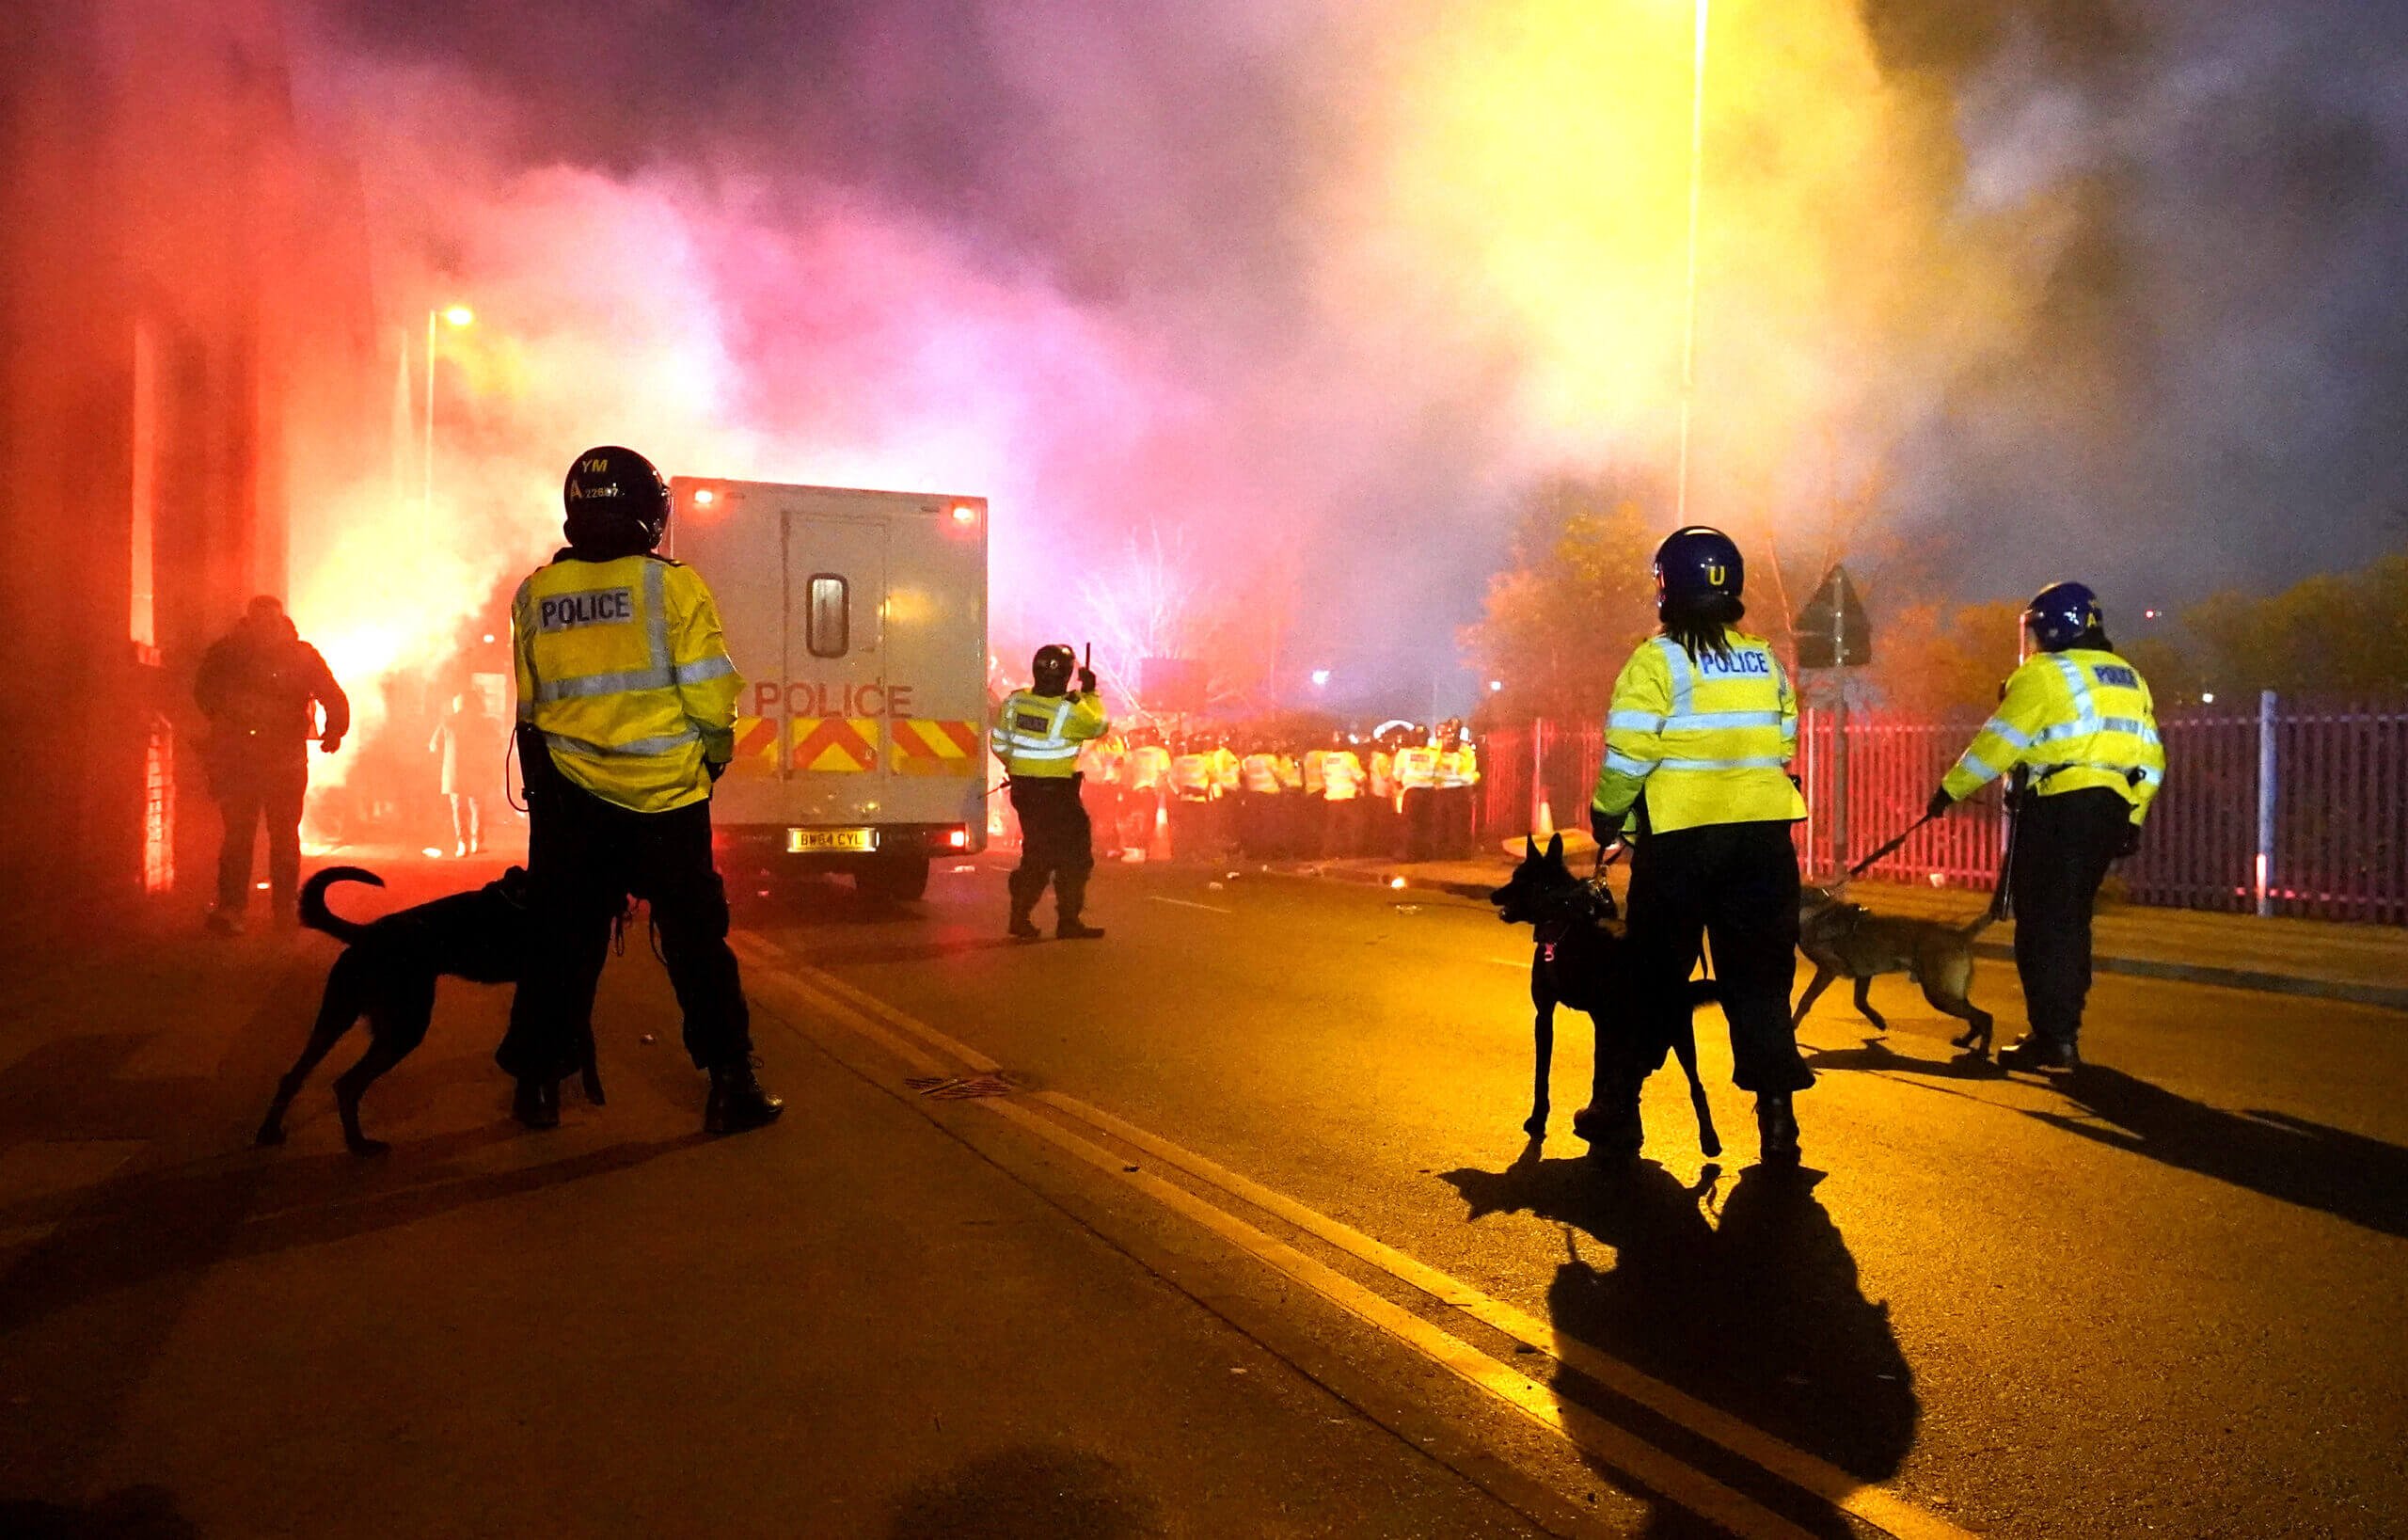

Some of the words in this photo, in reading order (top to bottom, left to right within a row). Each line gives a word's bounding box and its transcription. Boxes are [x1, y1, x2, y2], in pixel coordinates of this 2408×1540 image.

[581, 458, 609, 473] YM
[570, 479, 583, 502] A
[1709, 565, 1725, 586] U
[541, 592, 631, 628] POLICE
[1699, 650, 1769, 675] POLICE
[754, 681, 913, 719] POLICE
[837, 834, 860, 846] CYL
